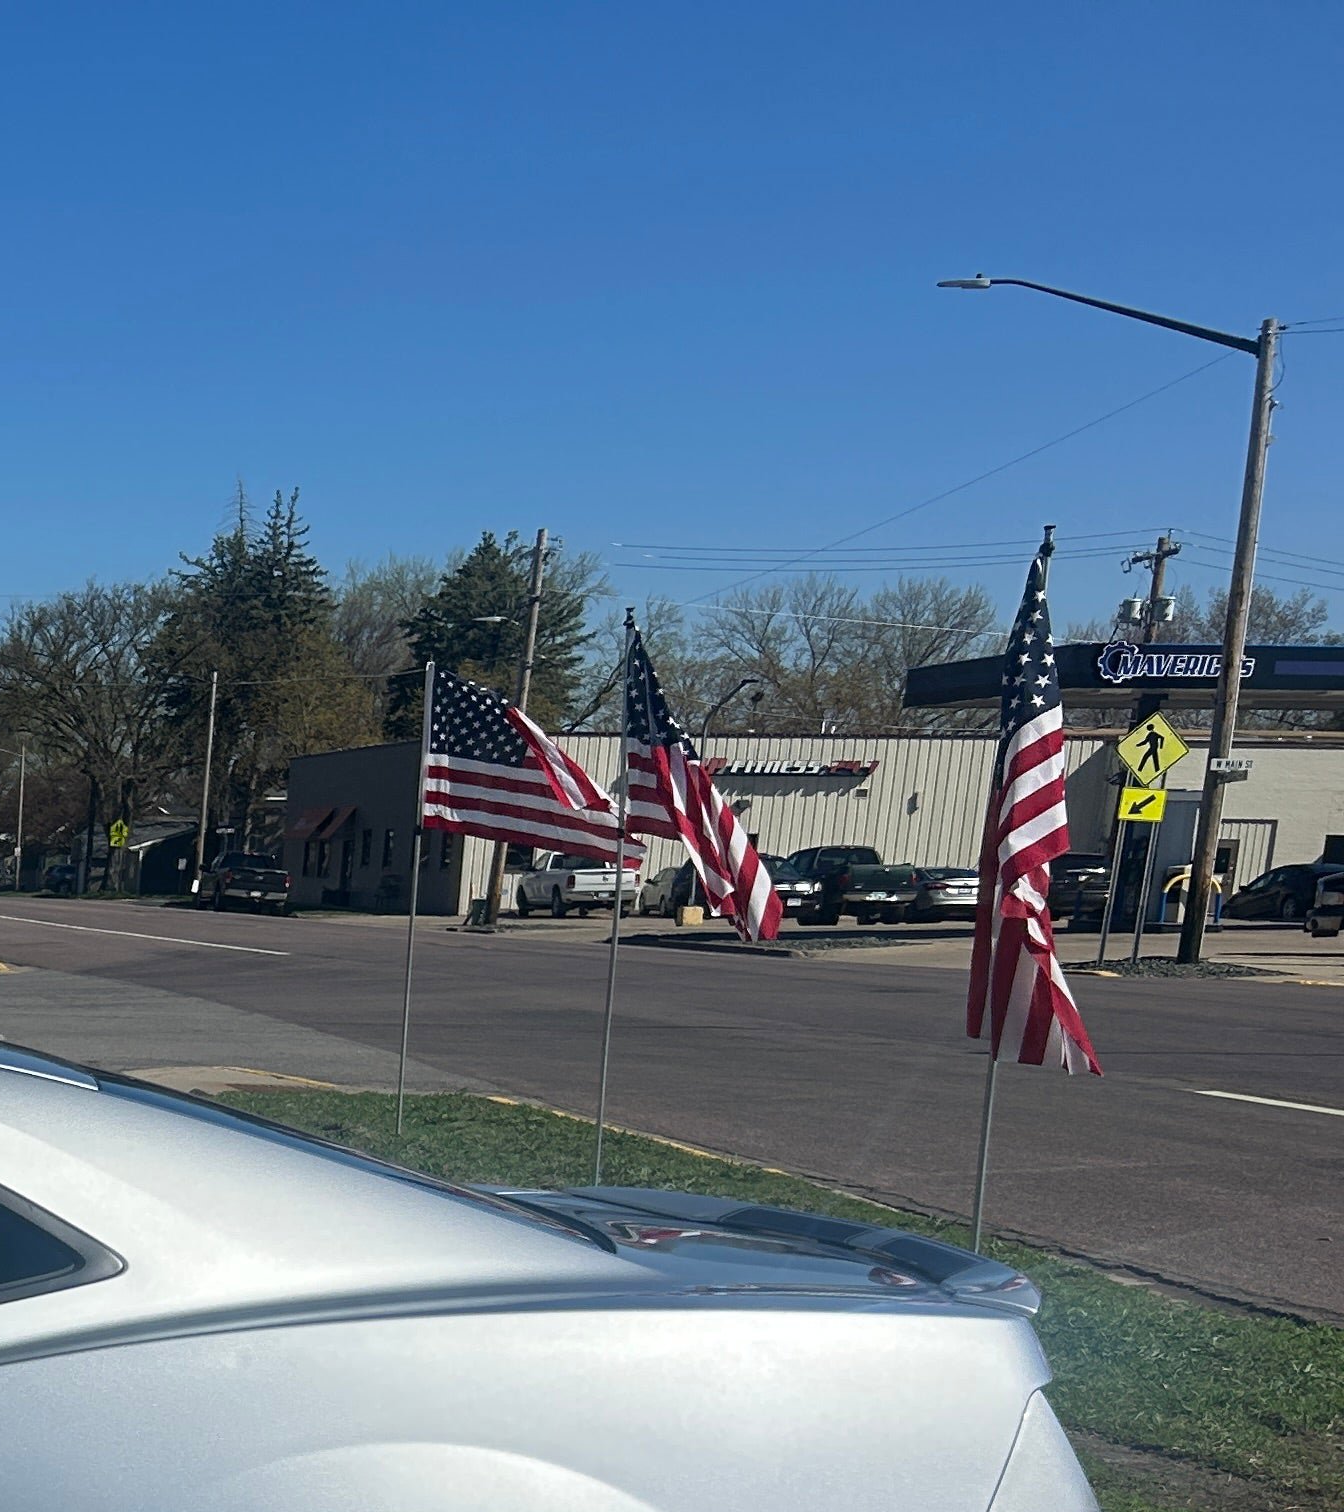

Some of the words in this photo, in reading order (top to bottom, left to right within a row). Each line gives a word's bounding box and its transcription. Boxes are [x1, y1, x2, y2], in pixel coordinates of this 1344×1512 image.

[730, 760, 822, 775] FITNESS
[1216, 760, 1223, 769] W
[1225, 760, 1243, 769] MAIN
[1245, 760, 1254, 769] ST
